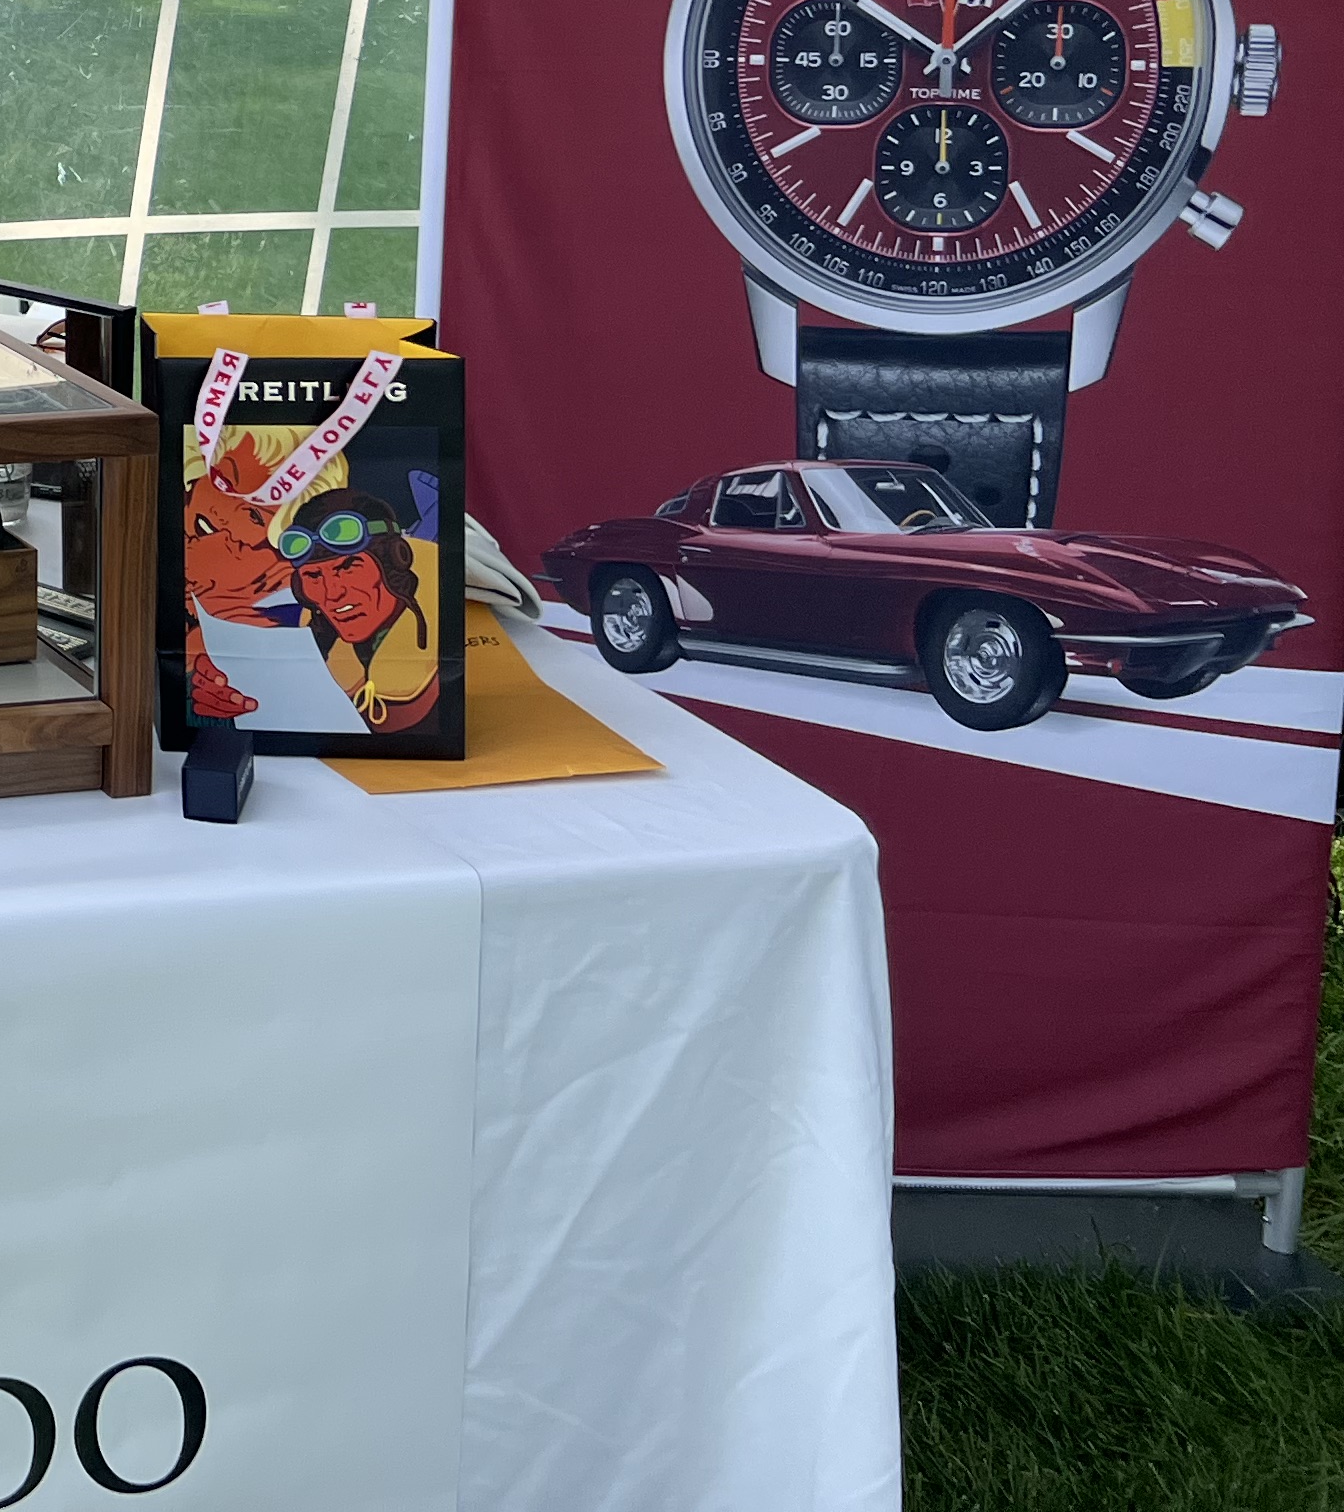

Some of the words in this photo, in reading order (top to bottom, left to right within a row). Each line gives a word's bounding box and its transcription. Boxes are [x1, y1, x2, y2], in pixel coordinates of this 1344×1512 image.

[824, 20, 851, 36] 60
[1045, 23, 1074, 39] 30
[703, 49, 720, 69] 80
[795, 52, 822, 68] 45
[859, 52, 878, 68] 15
[1018, 71, 1045, 88] 20
[1078, 72, 1097, 88] 10
[821, 84, 849, 101] 30
[909, 87, 939, 99] TOP
[953, 88, 981, 100] IME
[1173, 84, 1191, 114] 220
[708, 112, 727, 132] 85
[935, 128, 953, 144] 12
[1159, 122, 1182, 151] 200
[727, 162, 748, 184] 90
[900, 160, 914, 176] 9
[969, 161, 983, 176] 3
[1135, 165, 1160, 192] 180
[933, 192, 947, 208] 6
[756, 203, 778, 225] 95
[1094, 212, 1121, 238] 160
[788, 232, 816, 258] 100
[1063, 235, 1092, 260] 150
[822, 253, 850, 276] 105
[1026, 257, 1055, 278] 140
[857, 267, 885, 288] 110
[978, 273, 1008, 292] 130
[919, 281, 948, 296] 120
